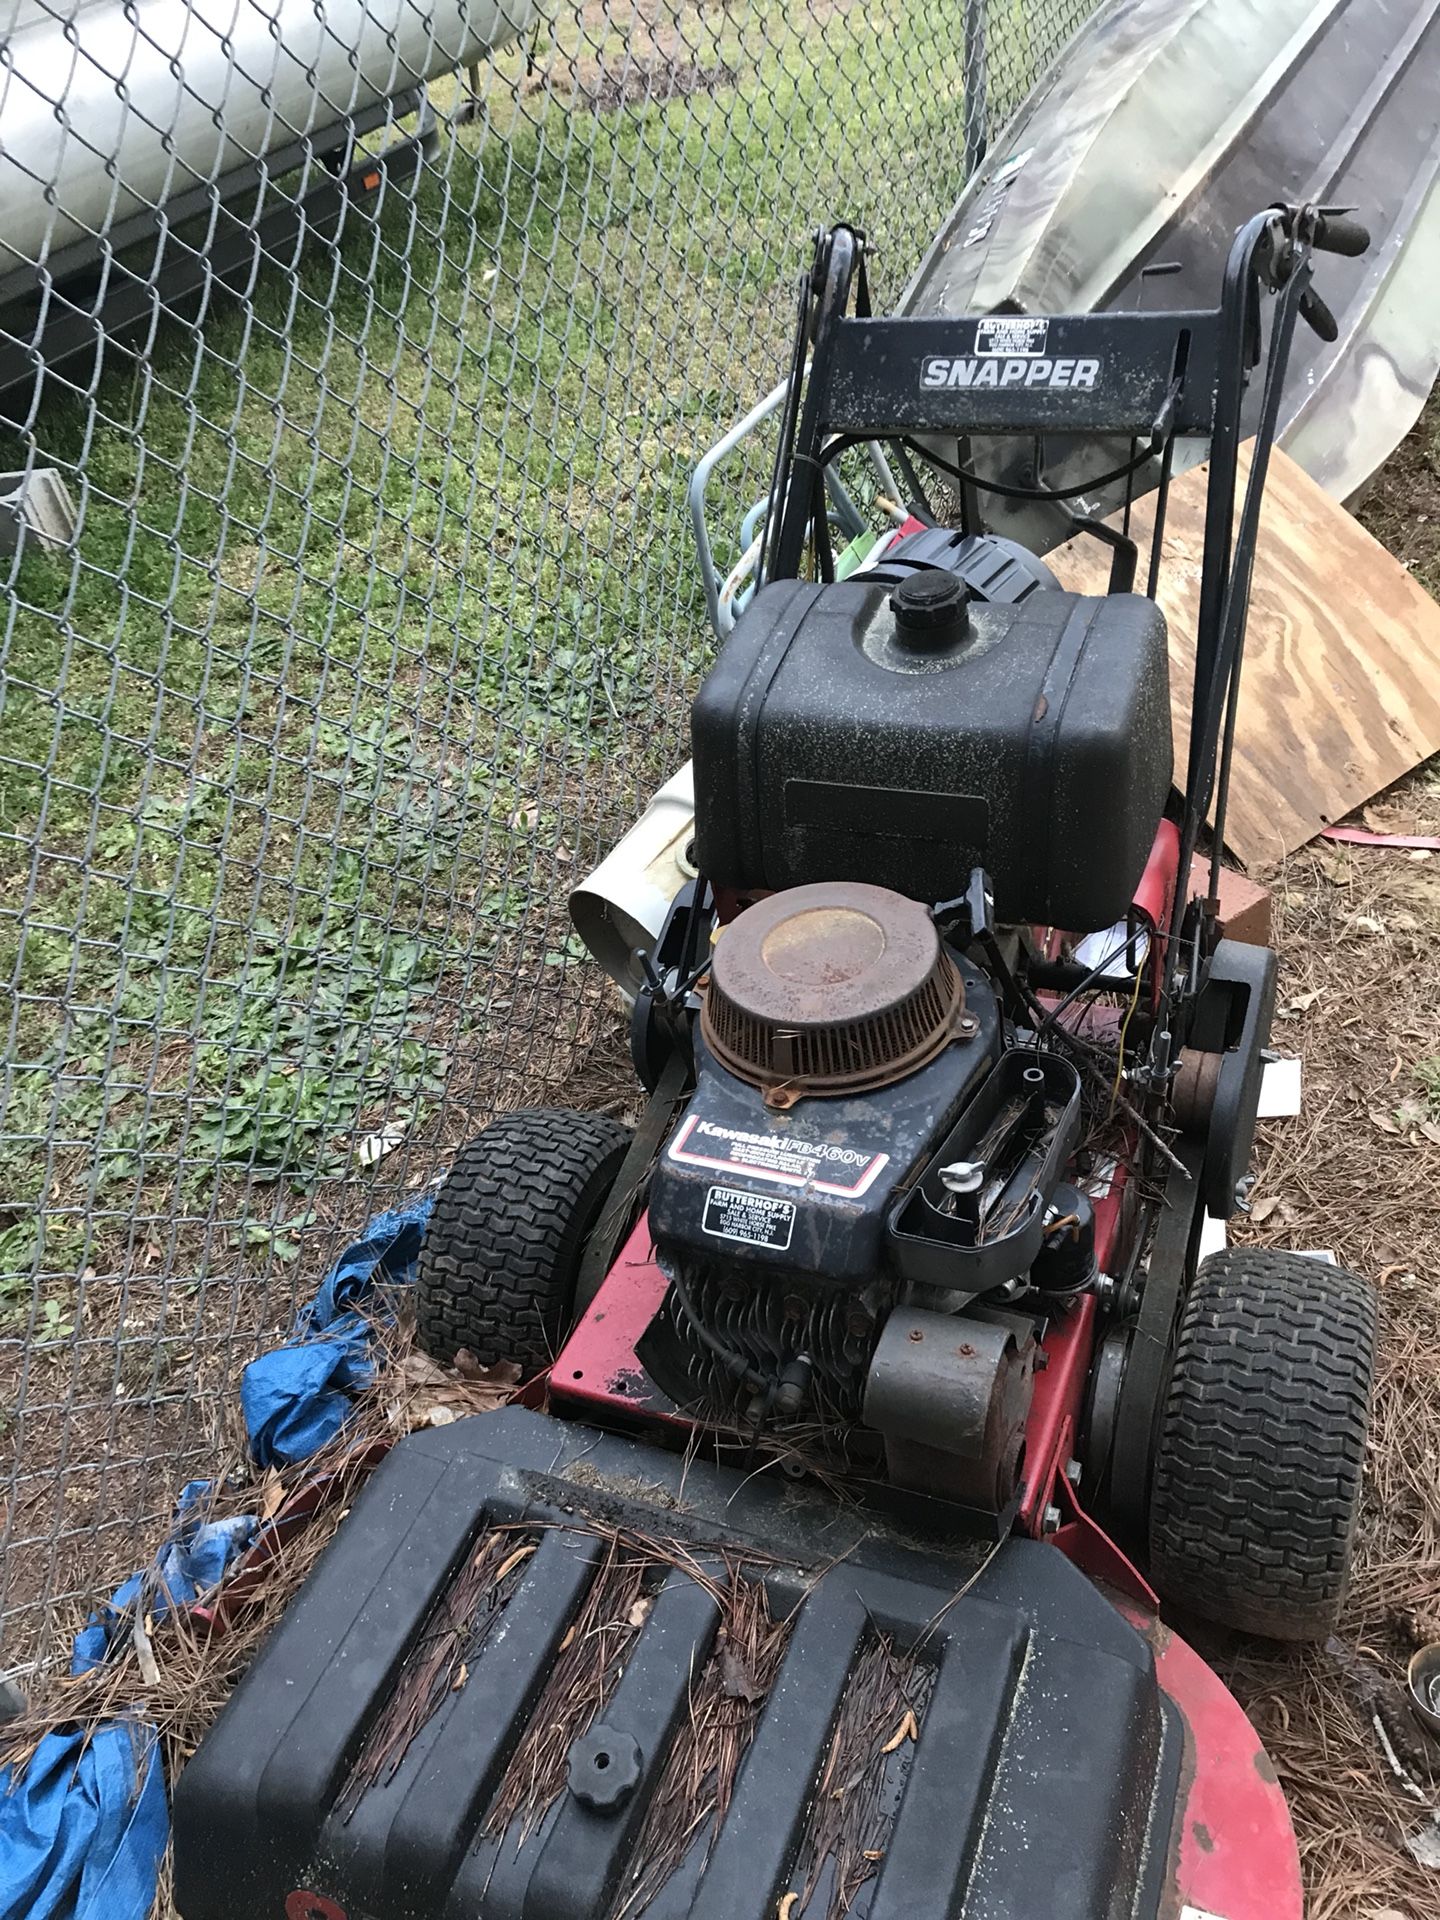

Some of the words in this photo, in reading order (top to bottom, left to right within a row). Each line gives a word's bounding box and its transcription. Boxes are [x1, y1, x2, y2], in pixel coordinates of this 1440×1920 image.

[924, 359, 1100, 387] SNAPPER
[696, 1120, 788, 1151] Kawasaki
[710, 1199, 728, 1208] FARM
[729, 1203, 744, 1211] AND
[746, 1206, 765, 1216] HOME
[767, 1211, 792, 1222] SUPPLY
[714, 1190, 790, 1214] BUTTERHOF'S
[727, 1209, 740, 1217] SALE
[748, 1213, 771, 1224] SERVICE
[732, 1216, 748, 1224] WHITE
[748, 1219, 765, 1228] HORSE
[766, 1223, 776, 1231] PIKE
[731, 1222, 752, 1231] HARBOR
[739, 1230, 769, 1243] 965-1198
